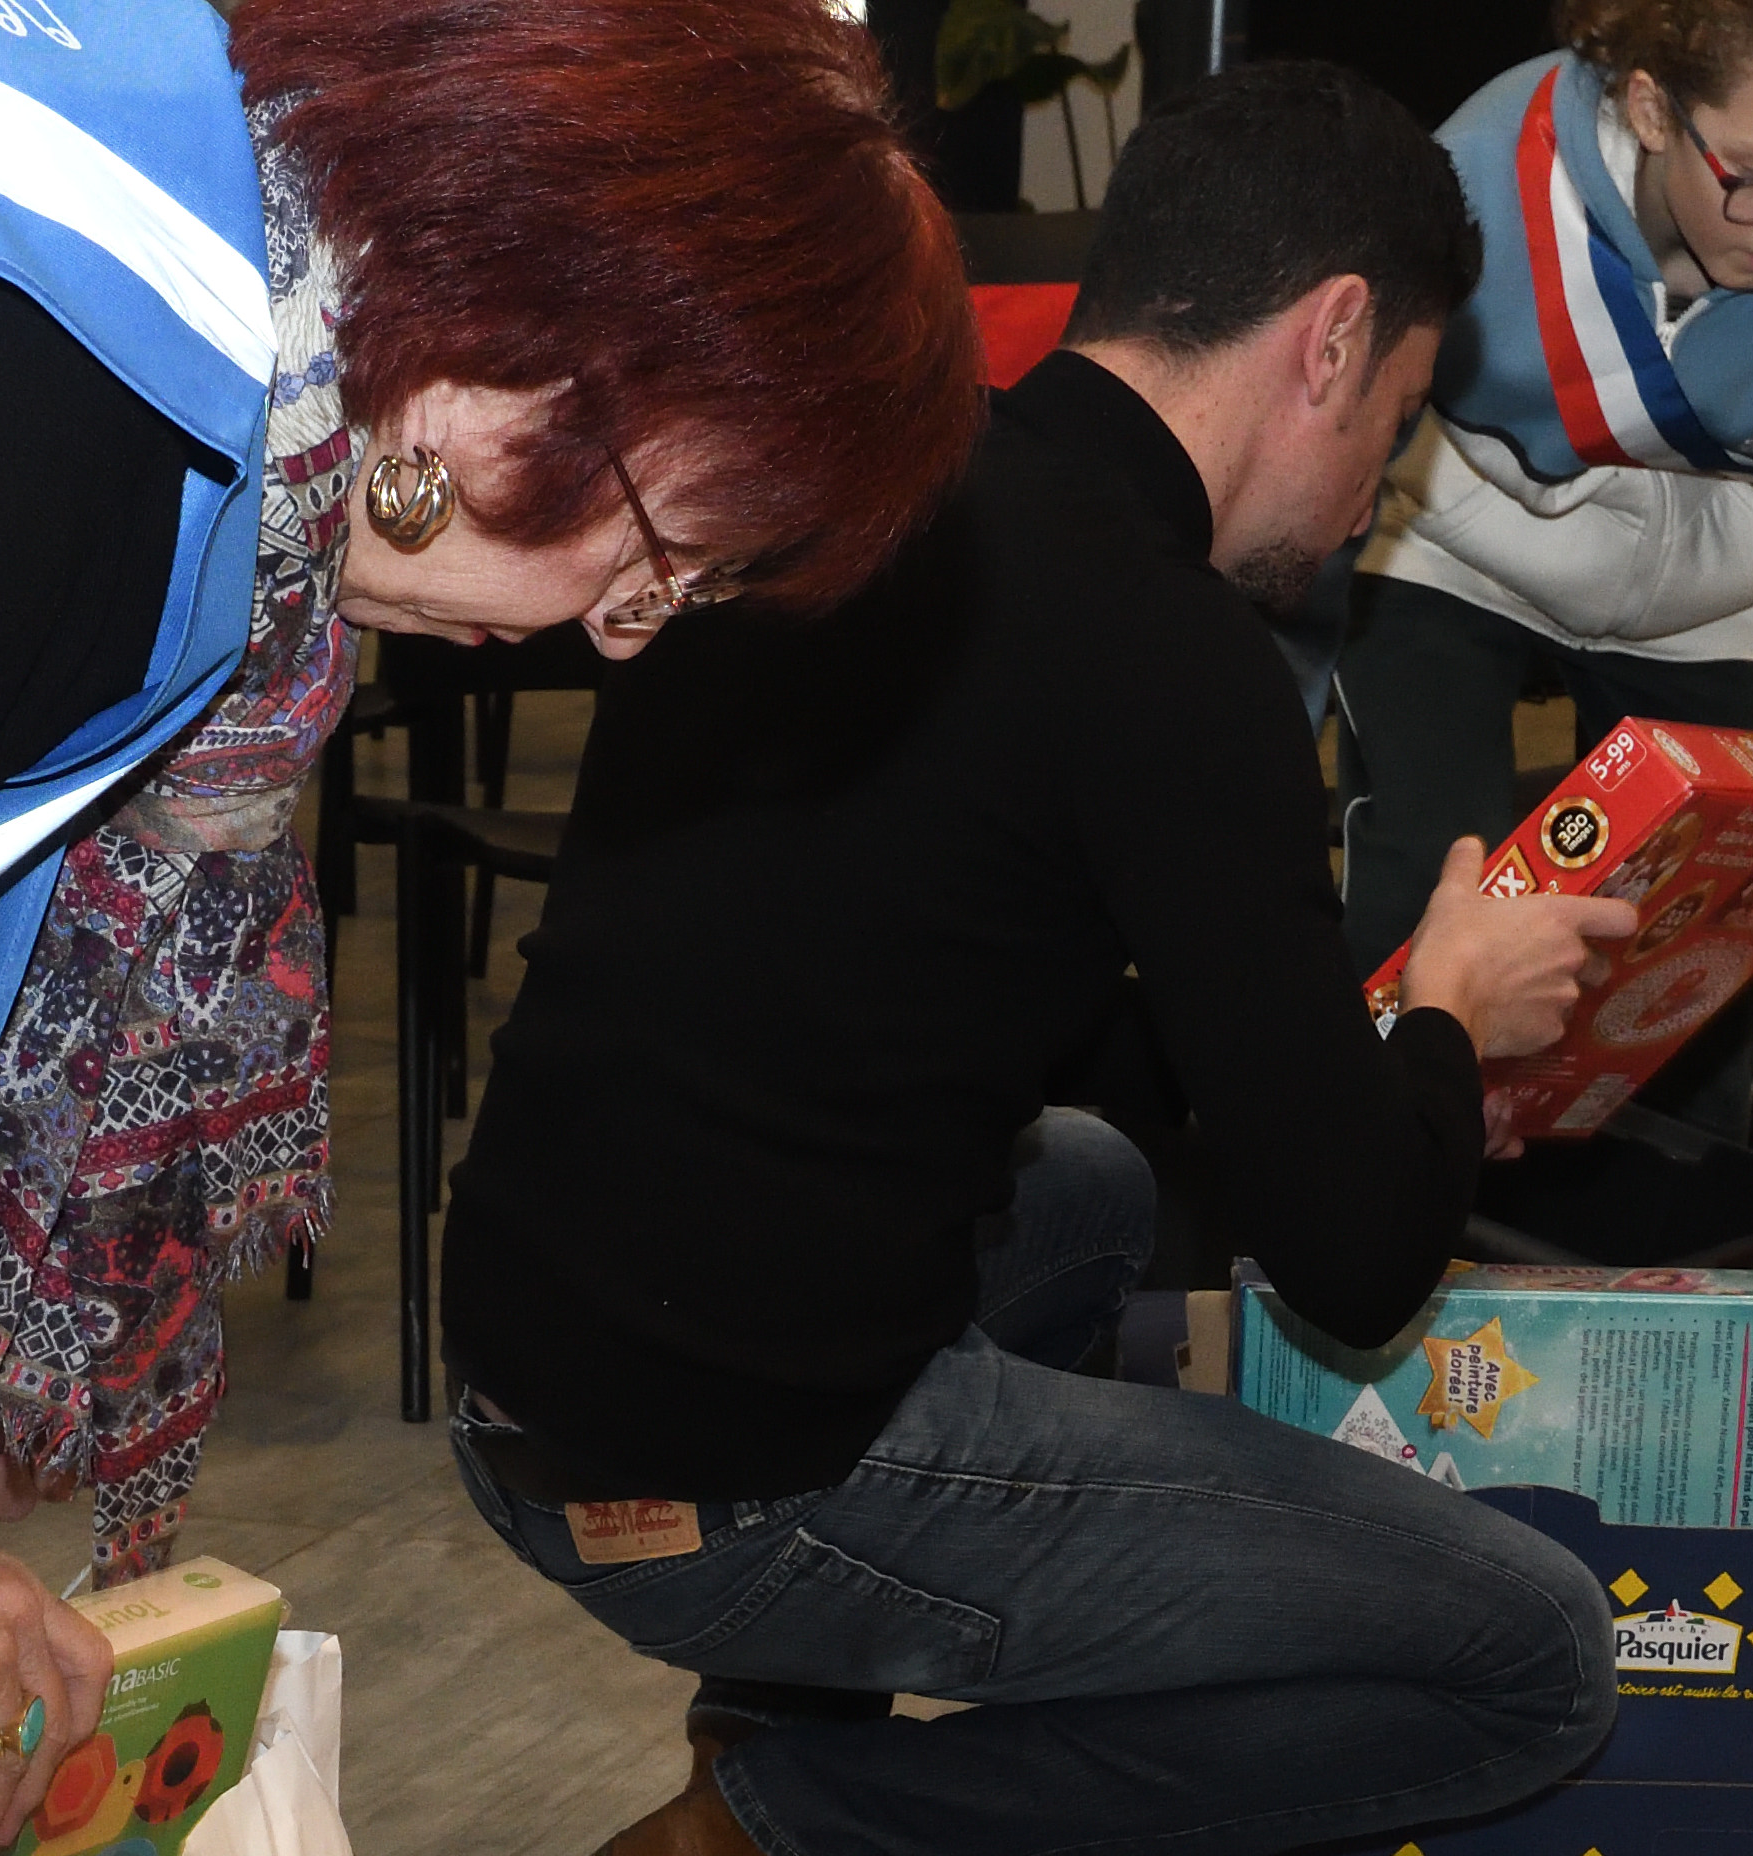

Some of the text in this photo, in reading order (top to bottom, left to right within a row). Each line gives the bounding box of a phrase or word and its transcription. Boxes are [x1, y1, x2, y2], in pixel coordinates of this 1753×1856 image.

[1590, 732, 1635, 780] 5-99
[1616, 760, 1631, 776] ans
[1557, 813, 1588, 846] 300
[1567, 823, 1594, 852] images
[1449, 1348, 1467, 1395] dorée
[1466, 1344, 1484, 1414] peinture
[1484, 1361, 1501, 1402] Avec
[1742, 1494, 1753, 1508] de
[1639, 1624, 1708, 1635] brioche
[1615, 1629, 1730, 1666] Pasquier
[108, 1657, 182, 1697] naBASIC
[1616, 1682, 1658, 1697] stoire
